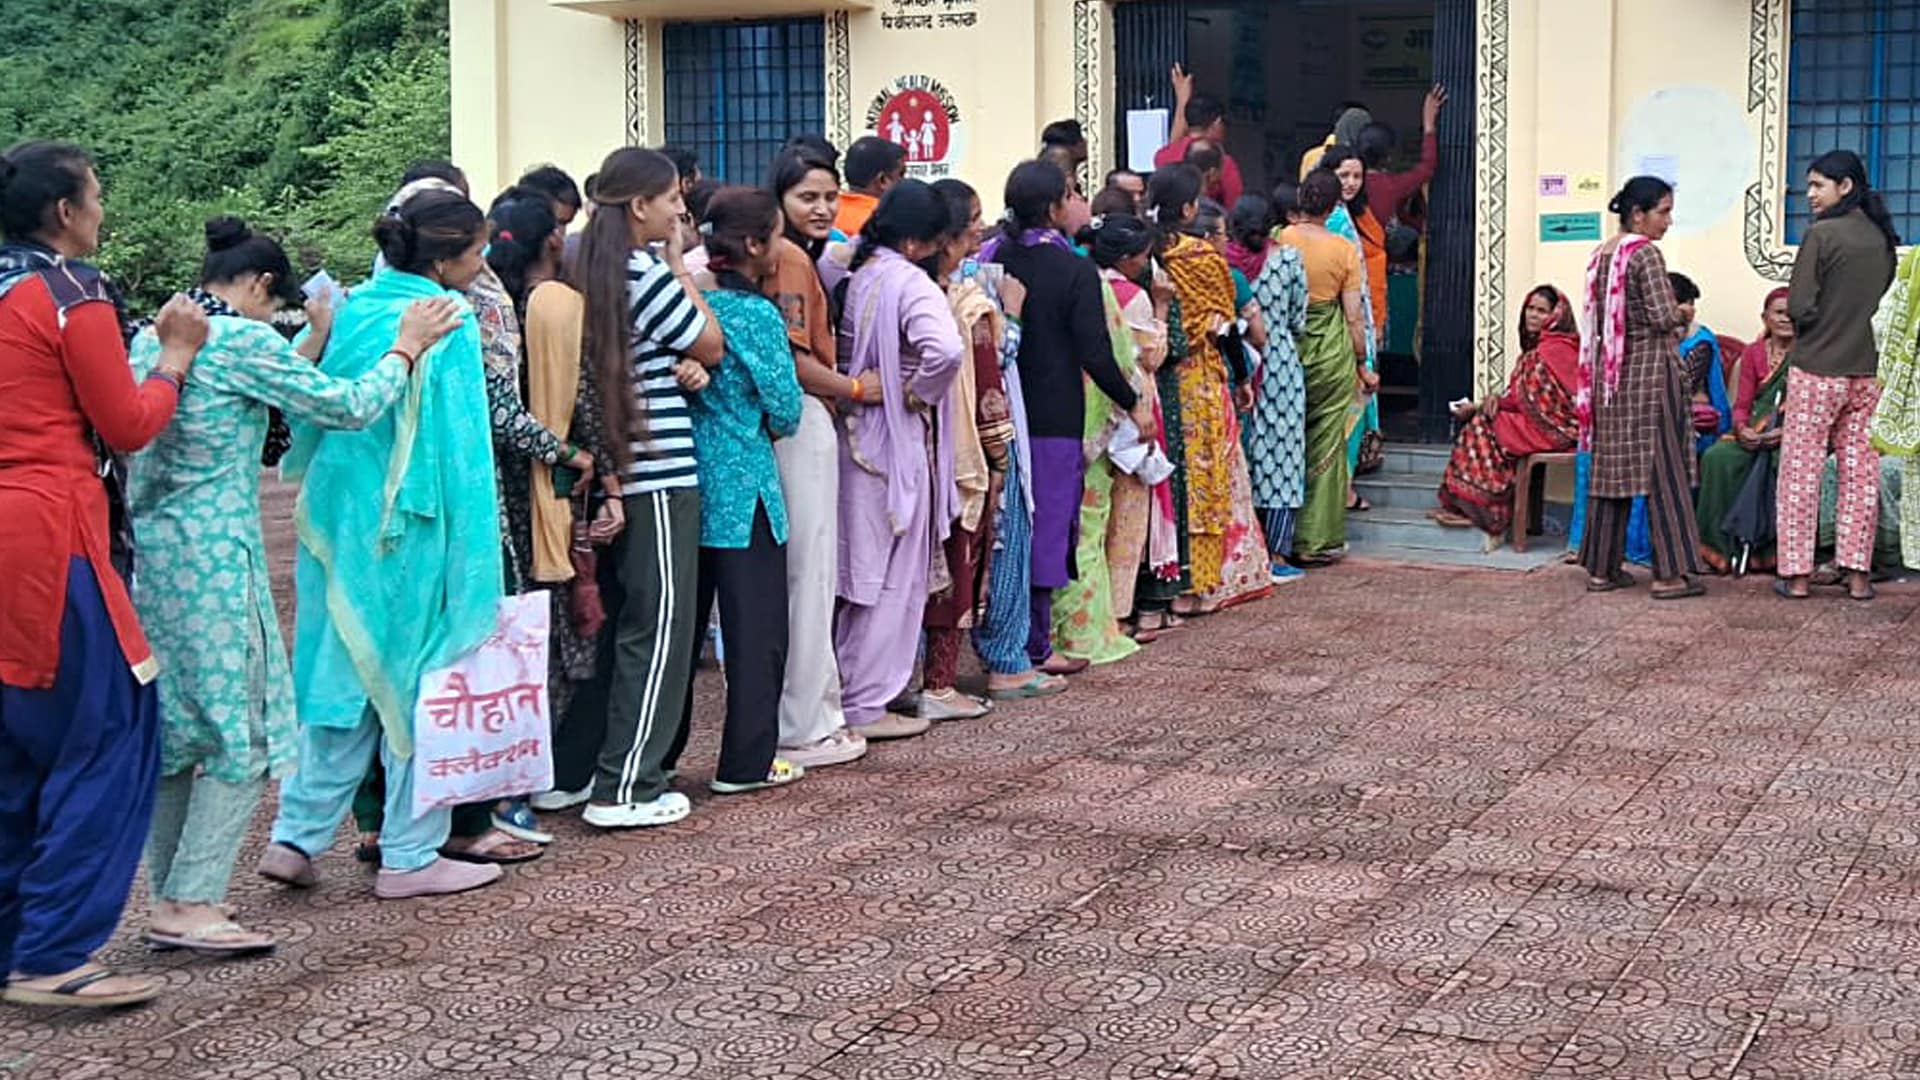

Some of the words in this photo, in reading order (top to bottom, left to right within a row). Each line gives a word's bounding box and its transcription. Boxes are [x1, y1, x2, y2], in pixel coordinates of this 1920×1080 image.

[866, 87, 895, 130] NATIONAL
[895, 75, 930, 91] HEALTH
[930, 79, 960, 124] MISSION
[423, 672, 543, 733] चौहान
